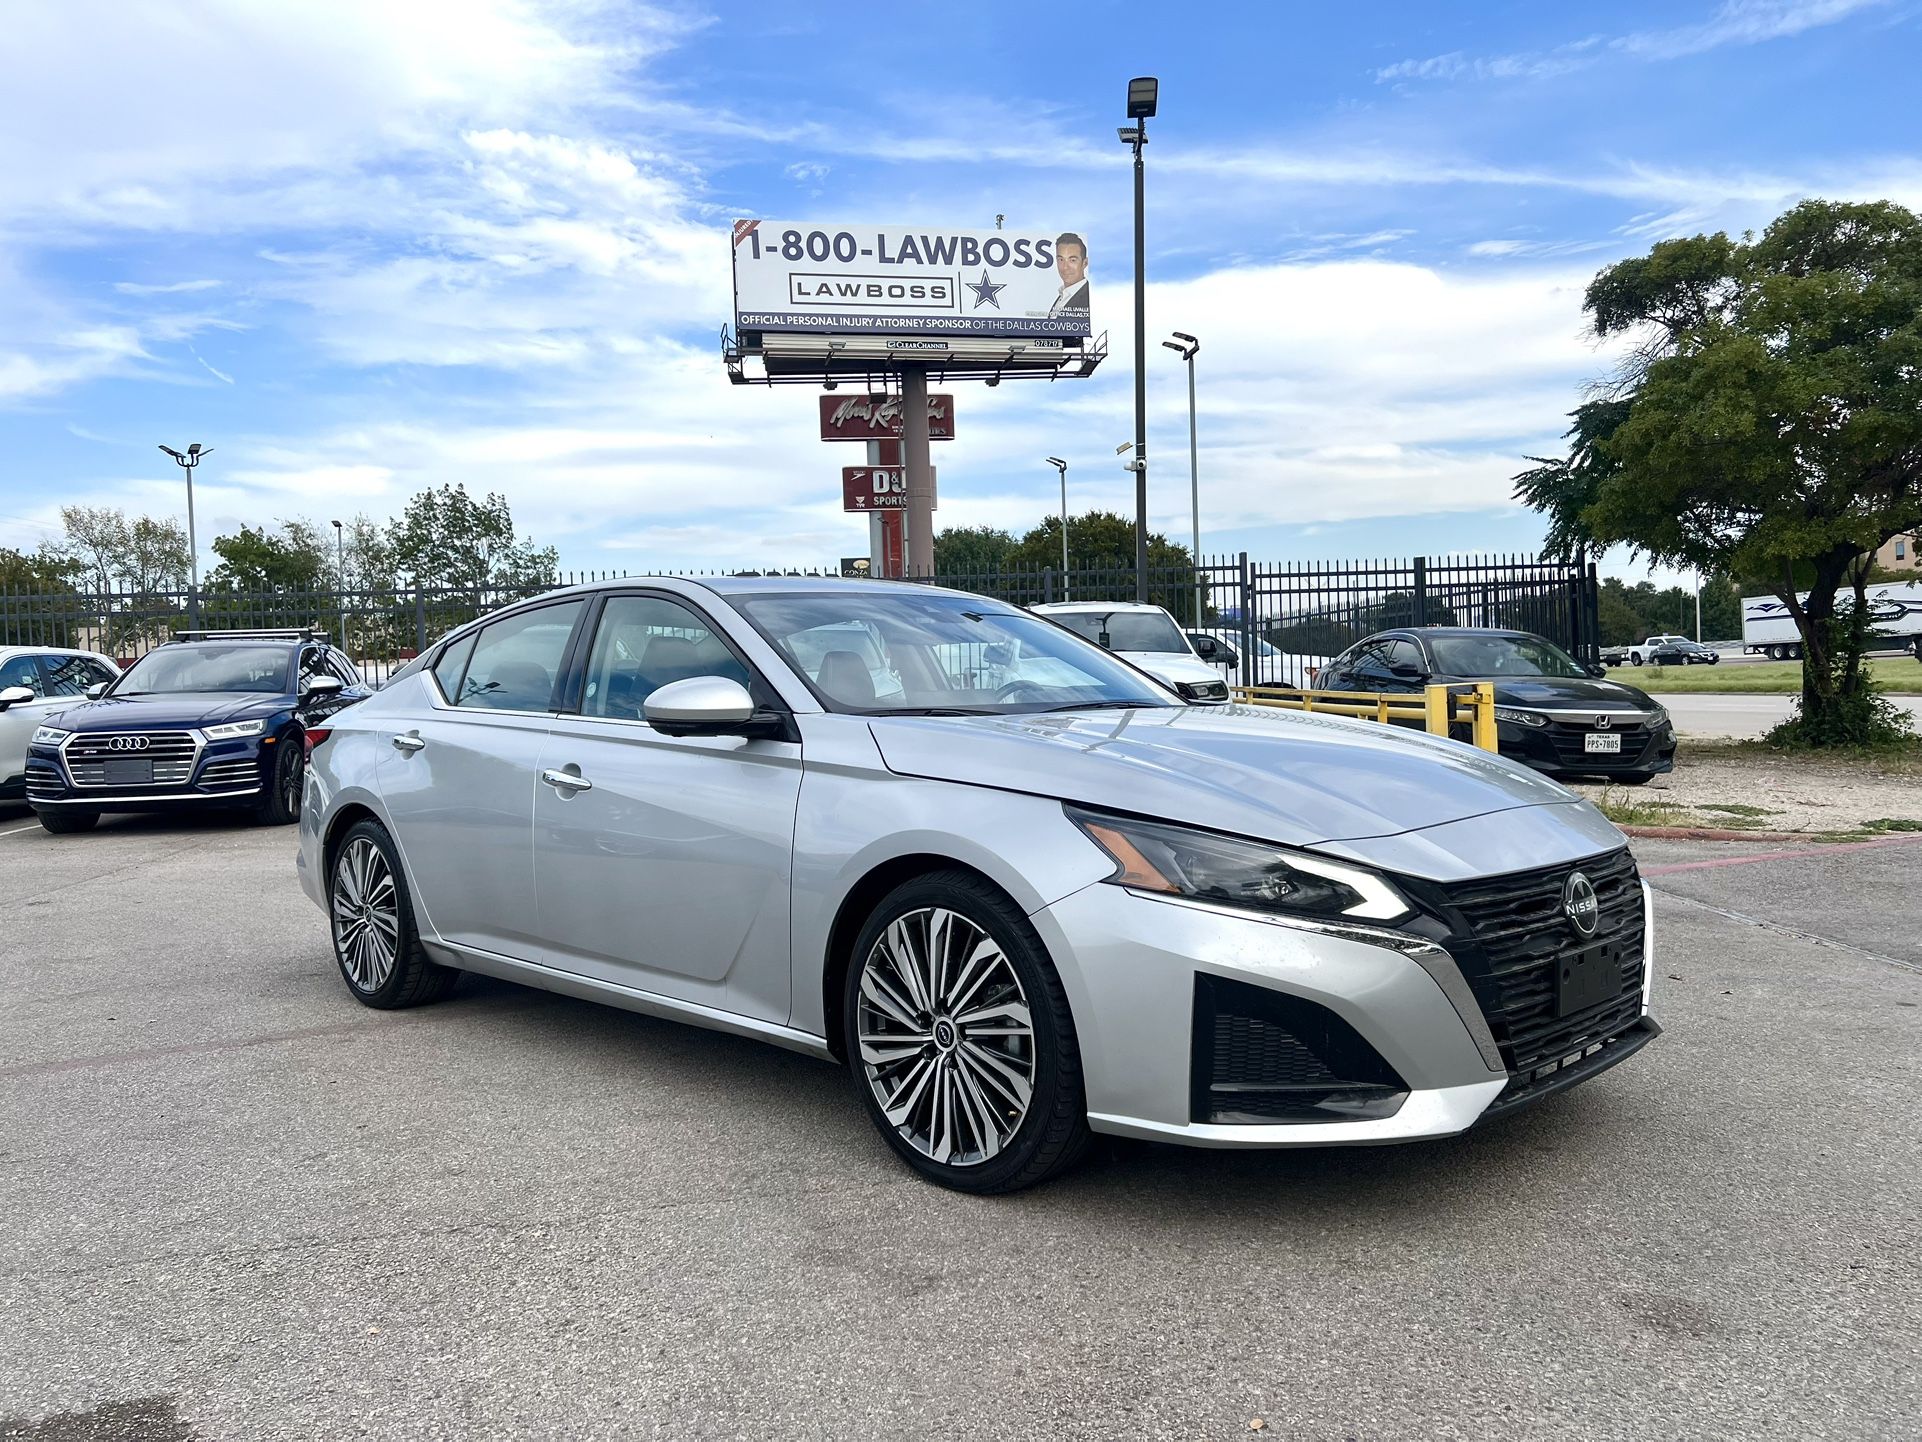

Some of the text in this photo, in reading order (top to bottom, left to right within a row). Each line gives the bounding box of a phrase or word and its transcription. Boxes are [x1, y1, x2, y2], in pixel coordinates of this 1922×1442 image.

[747, 229, 1054, 269] 1-800-LAWBOSS
[797, 282, 946, 299] LAWBOSS
[741, 315, 1090, 332] OFFICIAL PERSONAL INJURY ATTORNEY SPONSOR OF THE DALLAS COWBOYS
